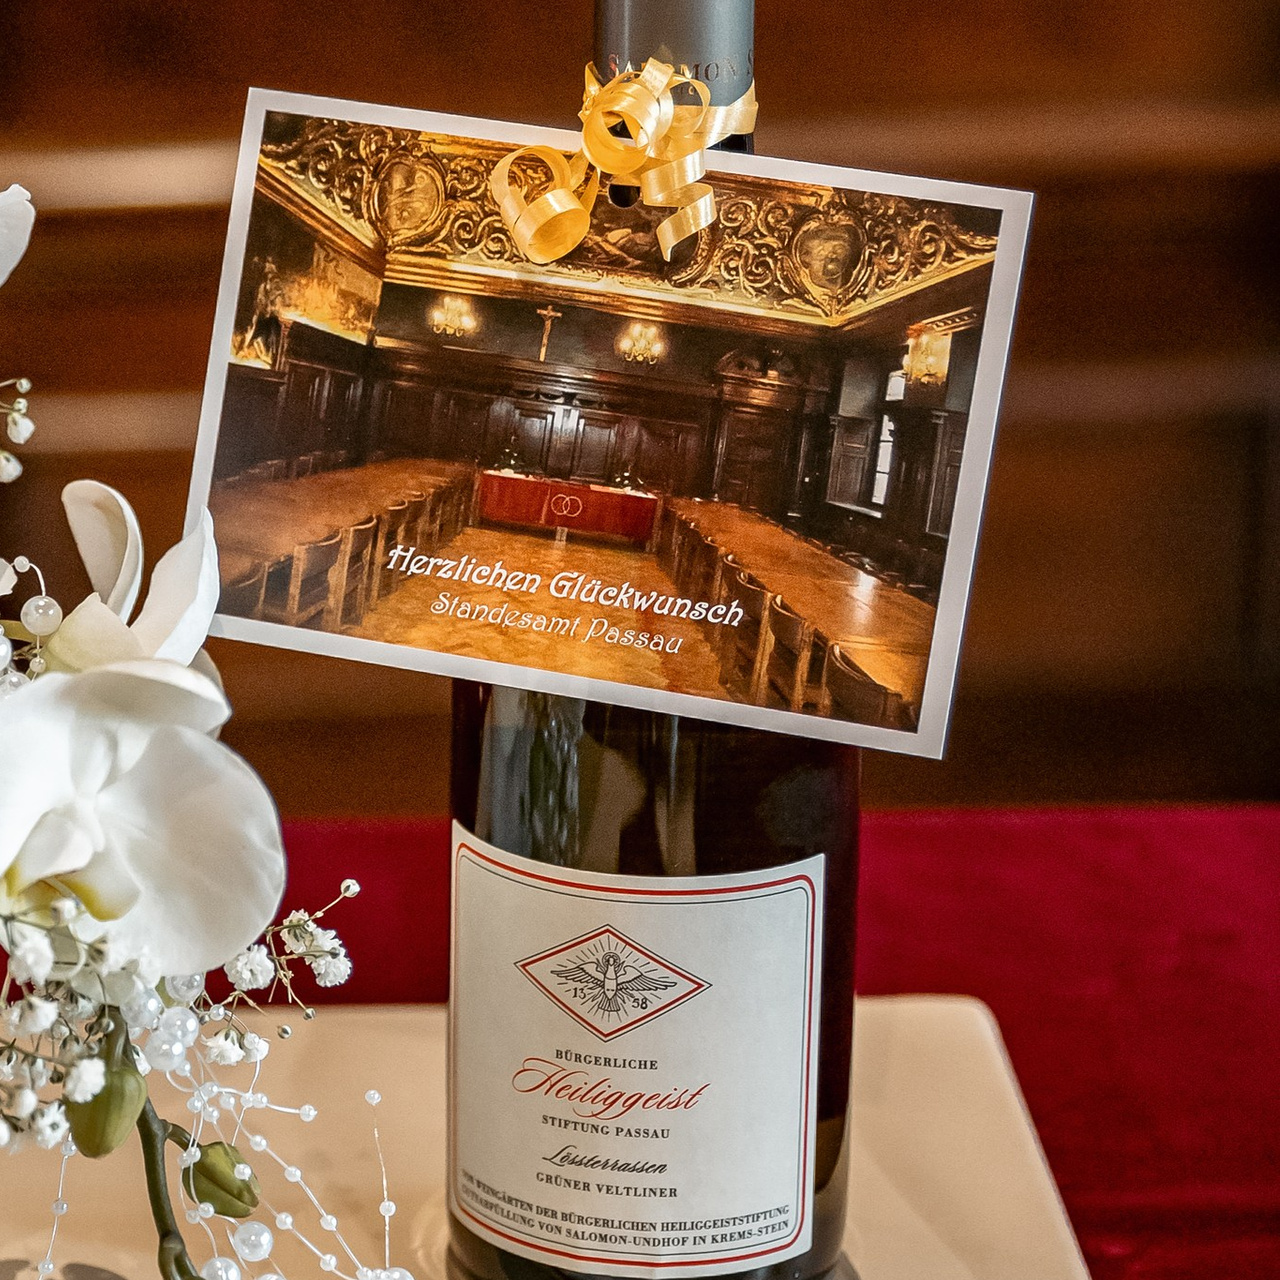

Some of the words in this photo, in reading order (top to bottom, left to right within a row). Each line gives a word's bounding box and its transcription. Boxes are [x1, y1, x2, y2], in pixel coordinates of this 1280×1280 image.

[608, 54, 738, 81] SAMON
[387, 543, 542, 594] Herzlichen
[549, 571, 745, 627] Glückwunsch
[430, 592, 581, 638] Standesamt
[584, 617, 684, 654] Passau
[572, 987, 587, 1000] 13
[631, 997, 648, 1010] 58
[555, 1049, 658, 1070] BÜRGERLICHE
[512, 1057, 711, 1120] Heiliggeist
[542, 1114, 610, 1135] STIFTUNG
[615, 1126, 670, 1139] PASSAU
[542, 1145, 667, 1174] Lössterrassen
[536, 1172, 591, 1192] GRÜNER
[596, 1183, 677, 1198] VELTLINER
[536, 1205, 558, 1220] DER
[560, 1210, 657, 1232] BÜRGERLICHEN
[661, 1205, 790, 1232] HEILIGGEISTSTIFTUNG
[539, 1222, 562, 1235] VON
[565, 1228, 689, 1247] SALOMON-UNDHOF
[693, 1235, 706, 1246] IN
[711, 1220, 790, 1244] KREMS-STEIN
